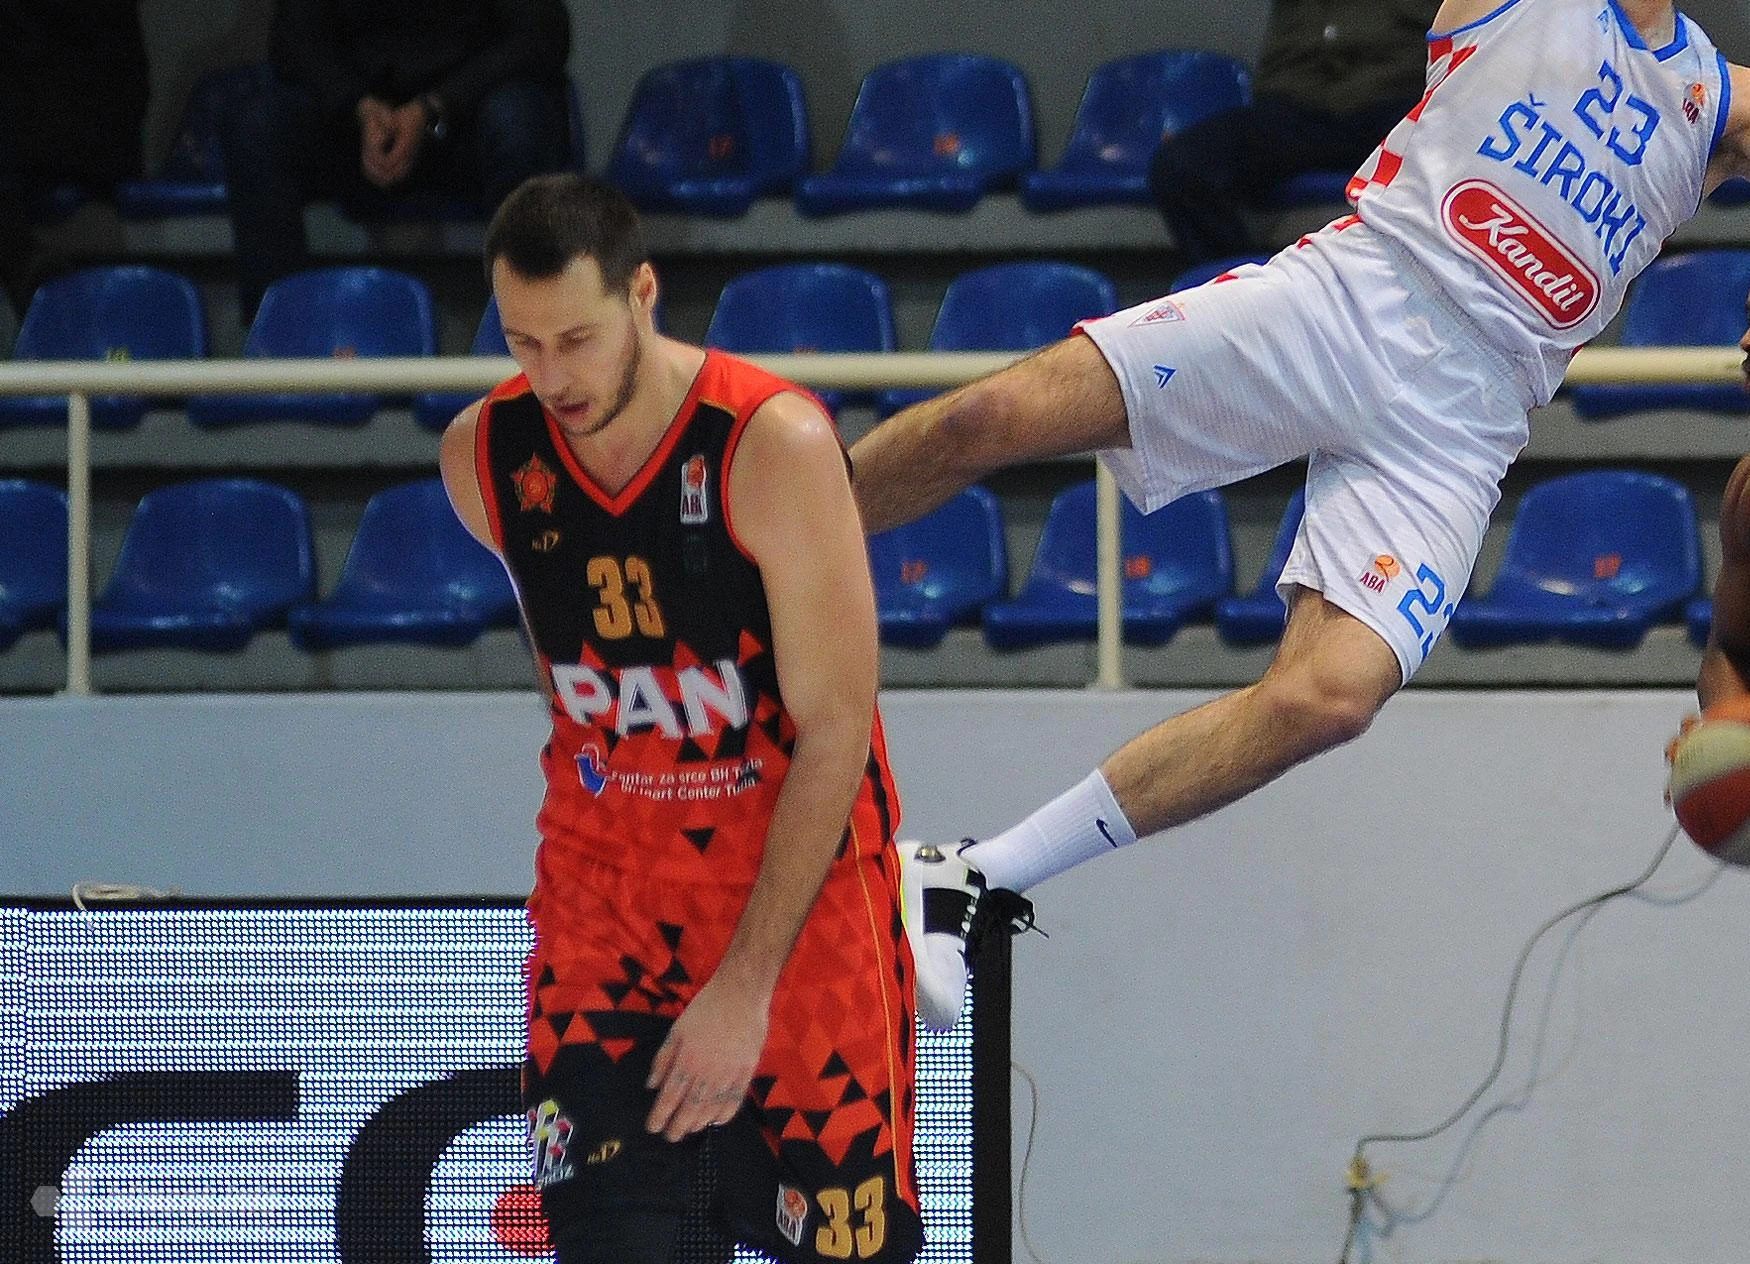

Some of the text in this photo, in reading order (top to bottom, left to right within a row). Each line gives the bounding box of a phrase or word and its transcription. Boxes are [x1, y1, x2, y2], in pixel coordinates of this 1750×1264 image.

[1572, 59, 1661, 167] 23
[587, 555, 665, 639] 33
[1360, 572, 1385, 593] ABA
[551, 659, 750, 740] PAN
[815, 1176, 886, 1259] 33
